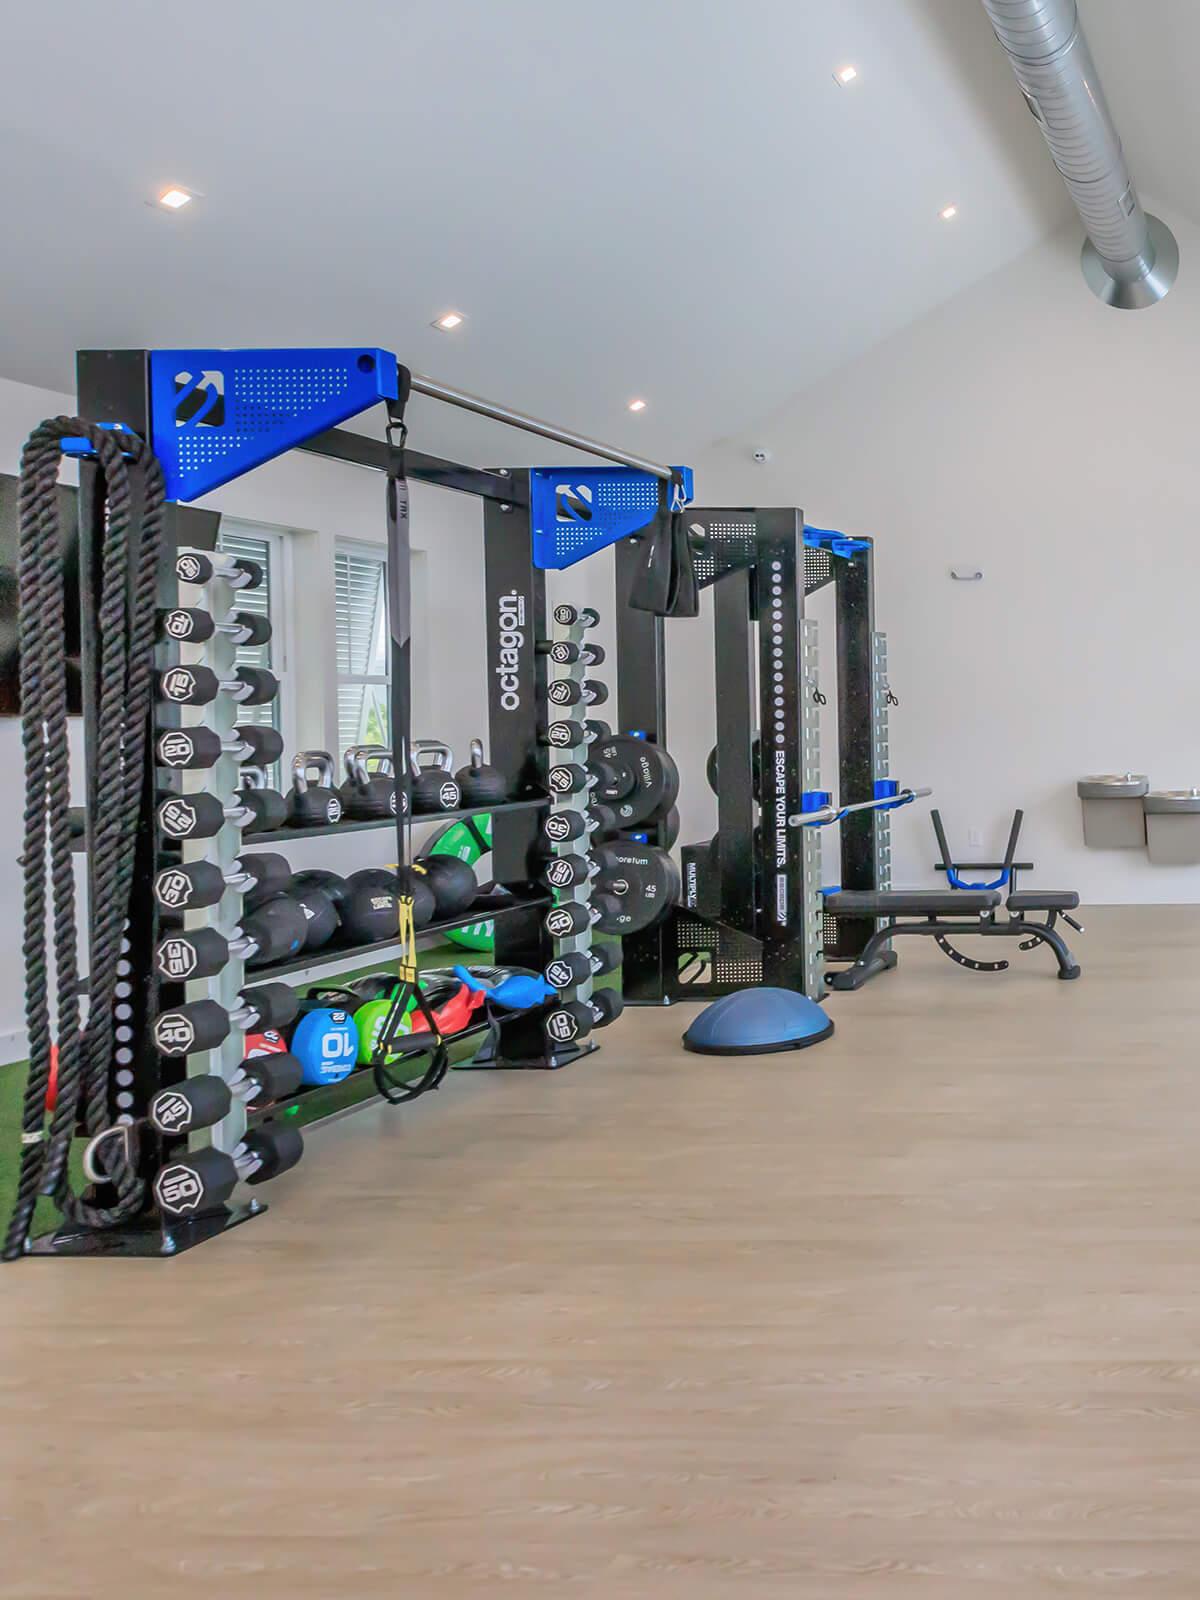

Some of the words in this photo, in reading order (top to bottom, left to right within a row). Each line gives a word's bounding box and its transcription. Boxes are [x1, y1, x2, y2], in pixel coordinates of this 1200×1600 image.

[171, 615, 186, 633] 10
[551, 730, 569, 740] 20
[164, 743, 190, 757] 20
[775, 750, 786, 794] ESCAPE
[442, 790, 457, 801] 45
[164, 804, 193, 829] 25
[775, 796, 787, 827] YOUR
[548, 821, 567, 833] 30
[775, 829, 787, 868] LIMITS.
[552, 862, 567, 882] 35
[687, 862, 697, 900] MULTIPLY
[164, 875, 186, 903] 30
[645, 884, 657, 893] 45
[550, 915, 571, 931] 40
[167, 942, 185, 974] 35
[551, 964, 570, 981] 45
[159, 1025, 191, 1043] 40
[322, 1032, 354, 1058] 10
[161, 1100, 187, 1125] 45
[162, 1178, 199, 1203] 50
